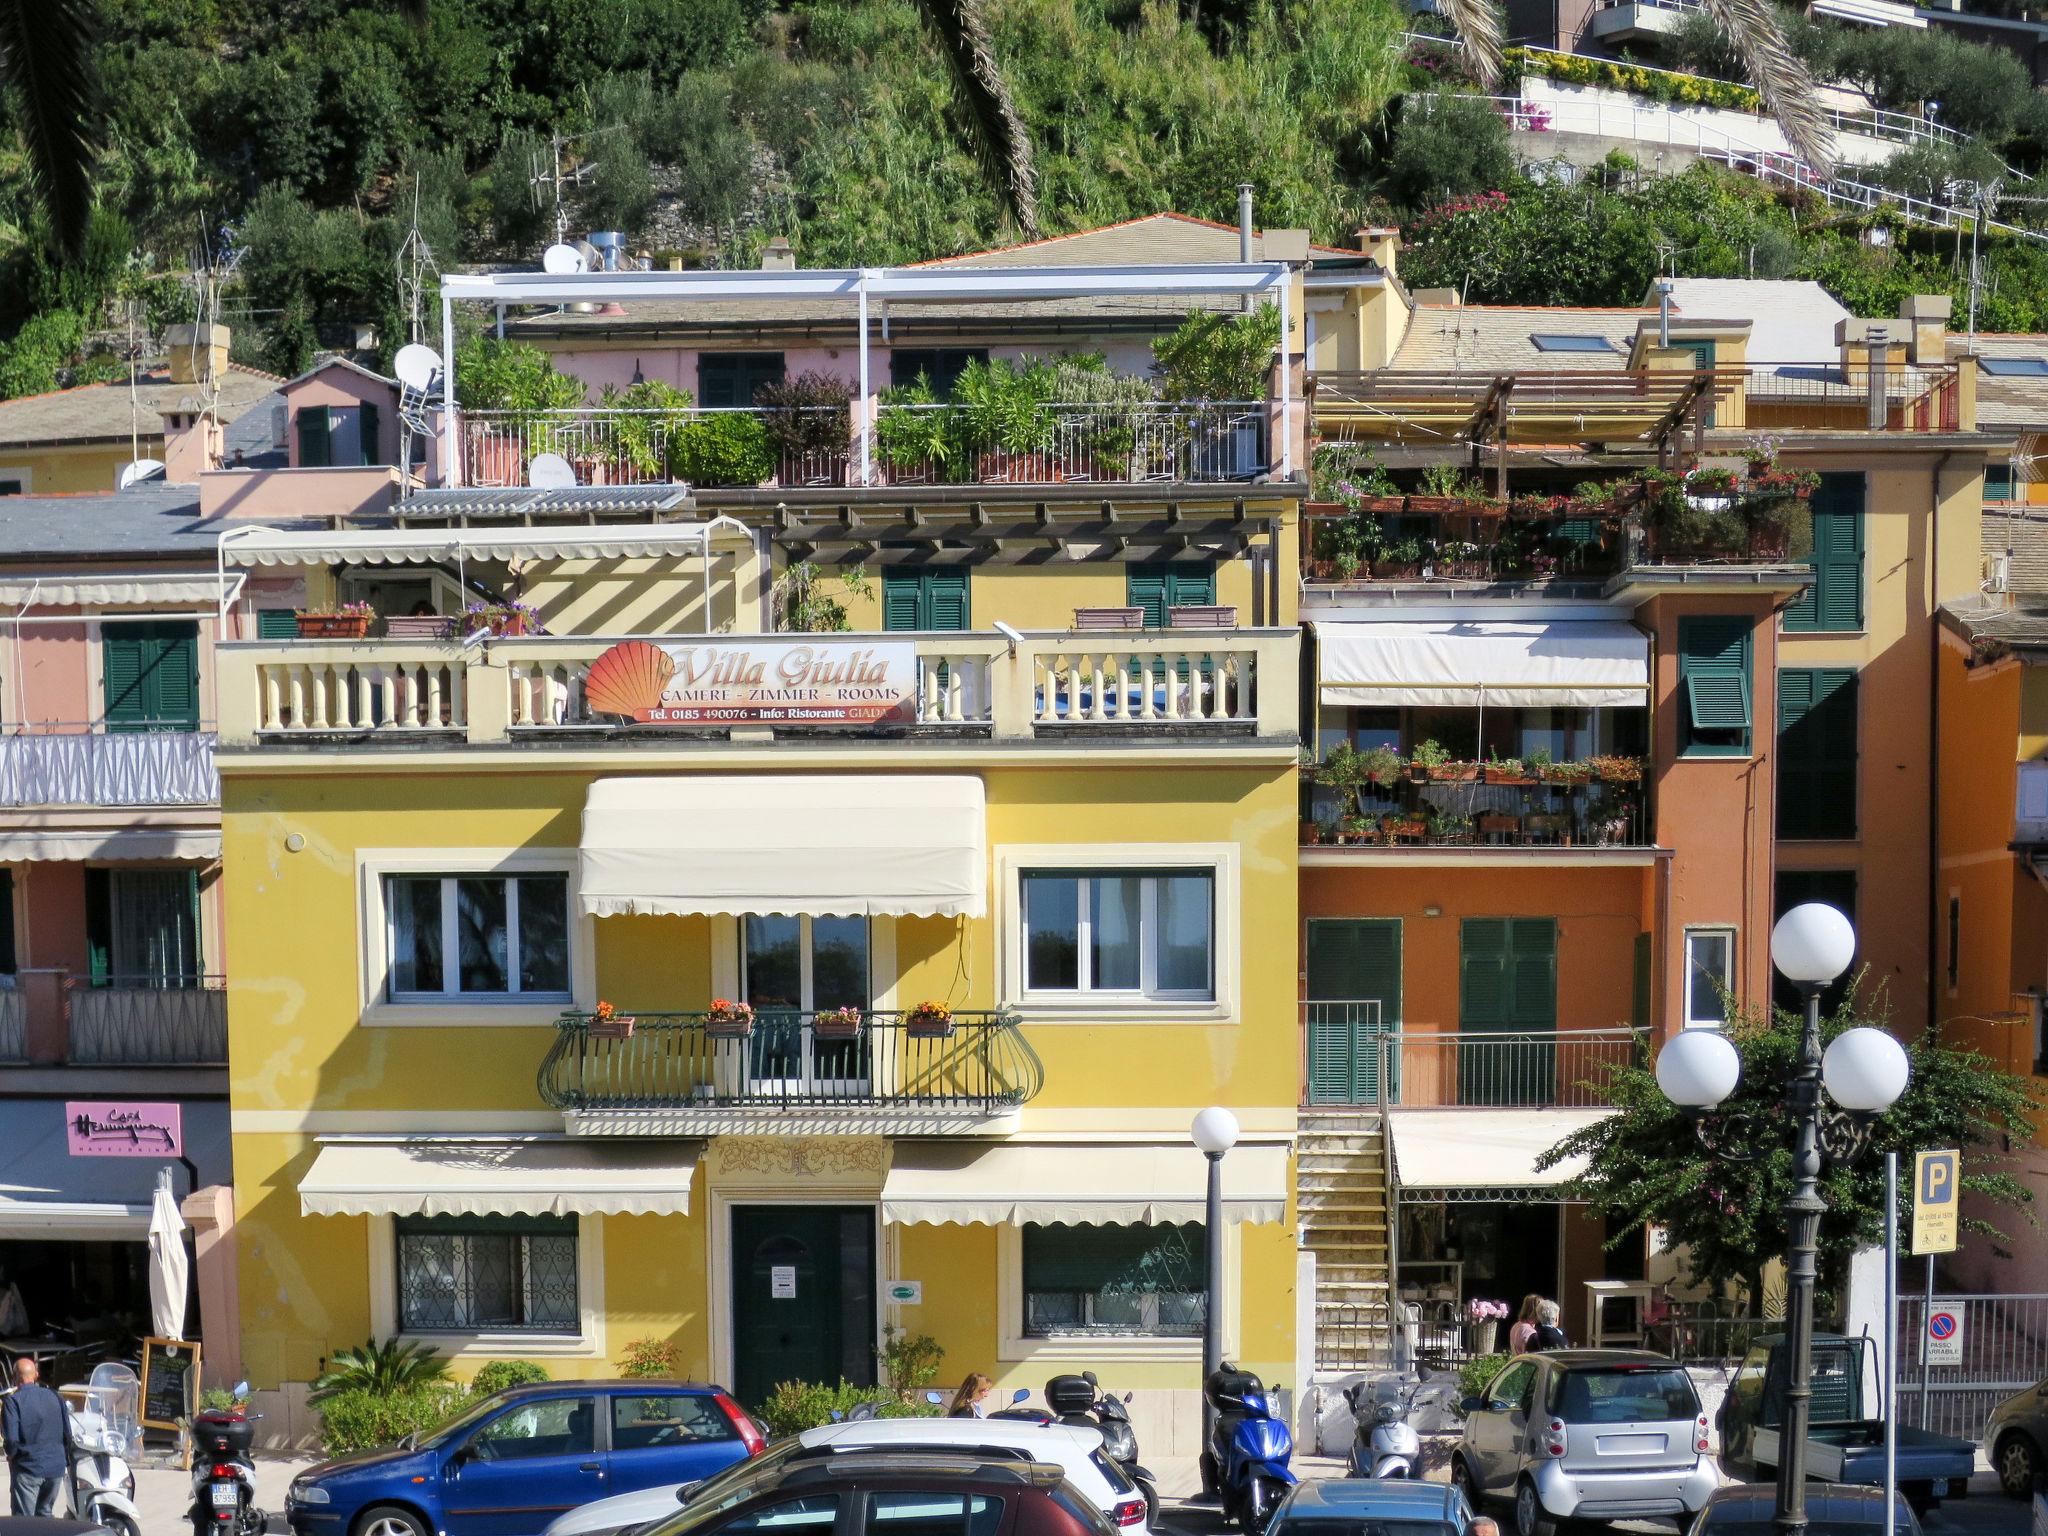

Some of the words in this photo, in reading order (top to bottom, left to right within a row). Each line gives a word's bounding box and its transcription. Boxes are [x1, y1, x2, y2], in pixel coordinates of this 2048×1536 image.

[662, 647, 767, 686] Villa
[778, 646, 890, 687] Giulia
[660, 689, 730, 702] CAMERE
[748, 688, 819, 701] ZIMMER
[837, 687, 900, 700] ROOMS
[648, 709, 667, 720] Tel.
[671, 709, 700, 720] 0185
[703, 708, 748, 720] 490076
[759, 707, 785, 719] Info:
[787, 708, 846, 719] Ristorante
[848, 707, 888, 719] GIADA
[1929, 1163, 1947, 1198] P
